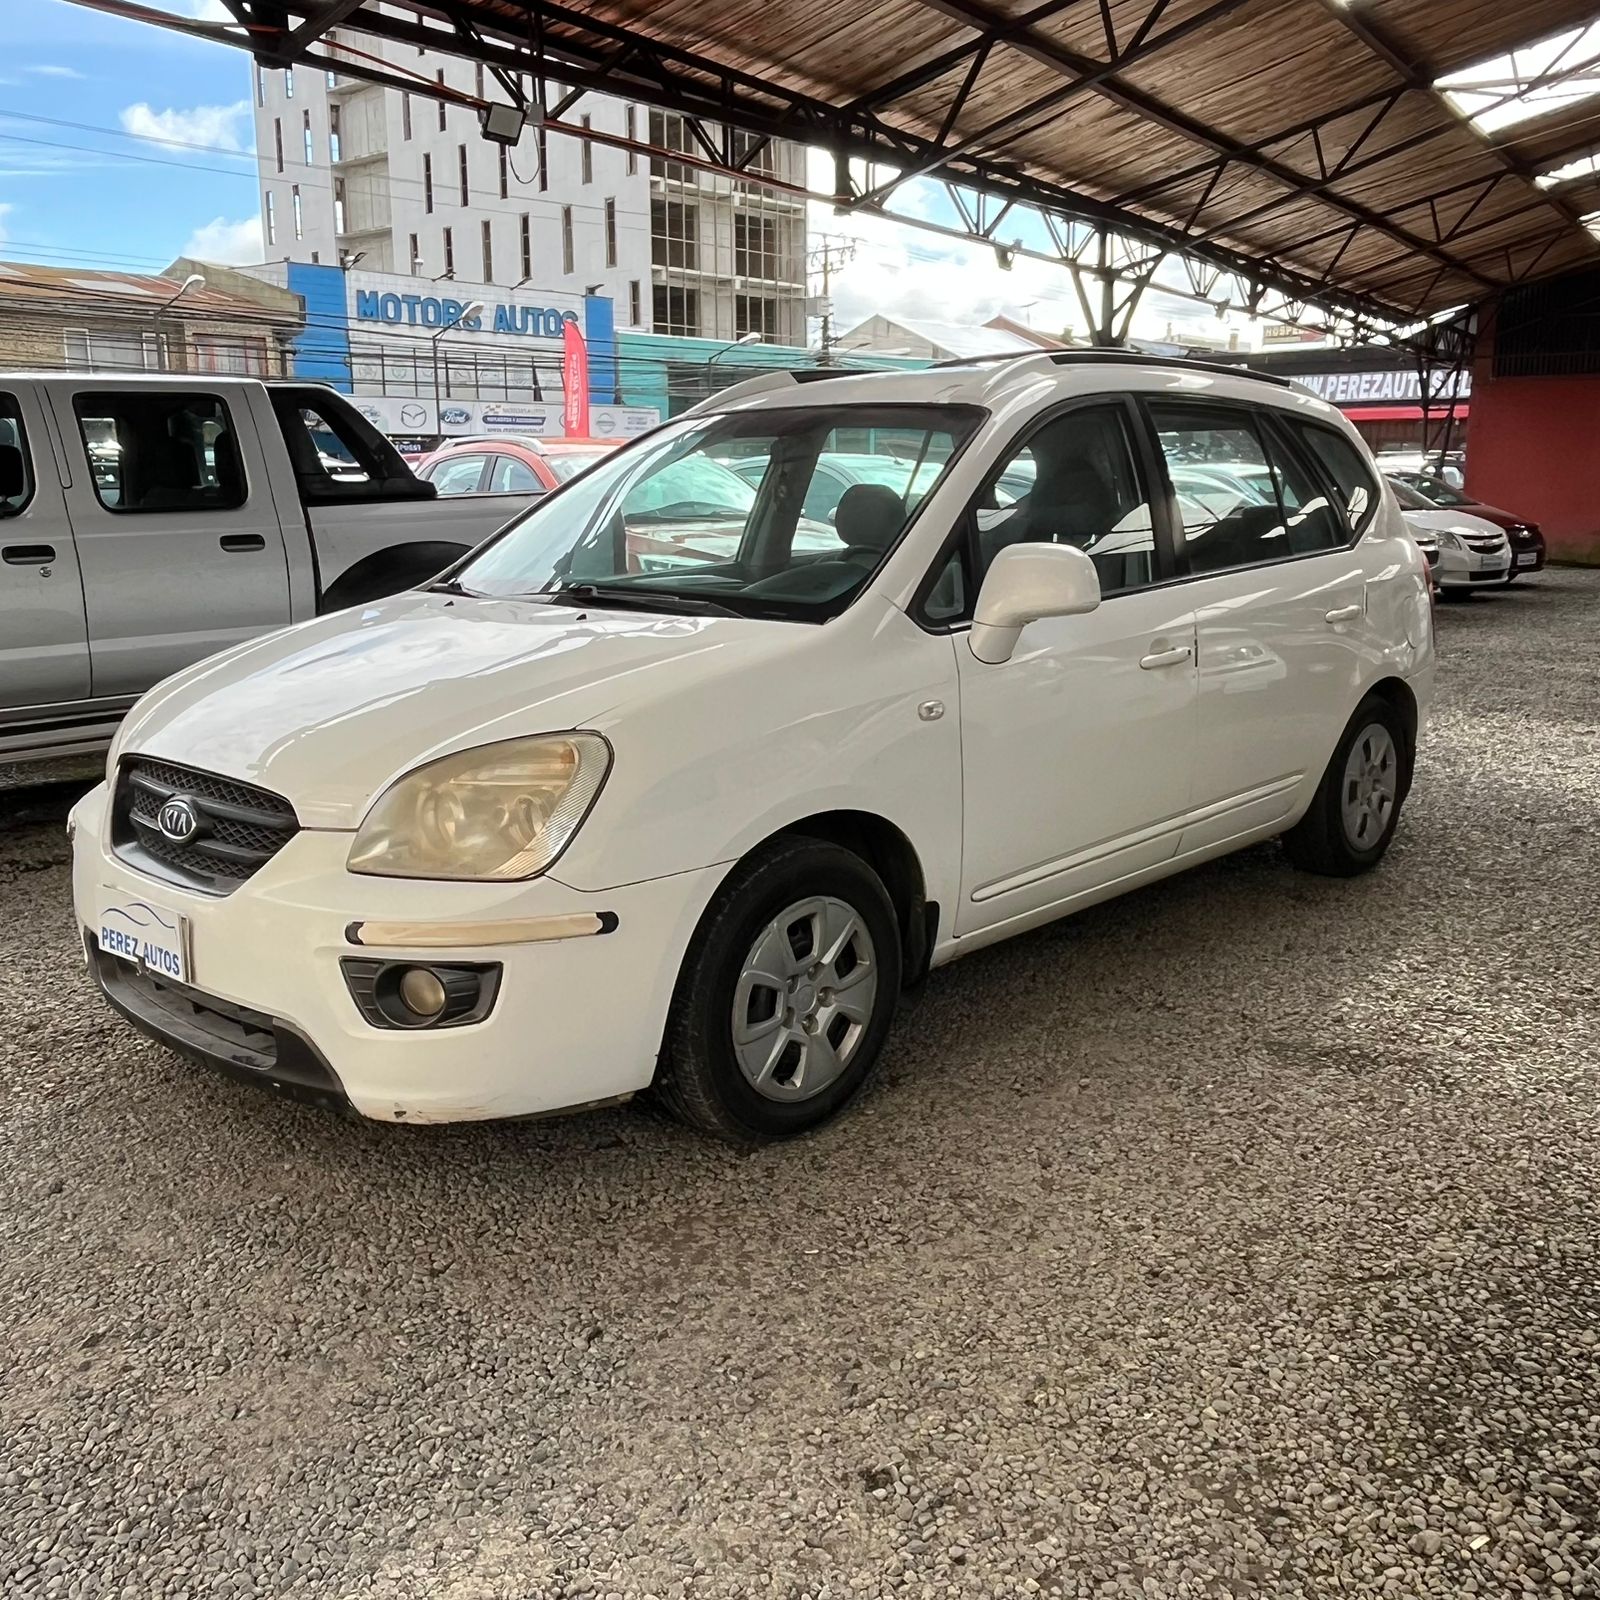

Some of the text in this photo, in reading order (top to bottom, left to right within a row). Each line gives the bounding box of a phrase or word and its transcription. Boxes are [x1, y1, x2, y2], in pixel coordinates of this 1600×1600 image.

[165, 808, 187, 834] KIA
[101, 926, 180, 976] PEREZ AUTOS
